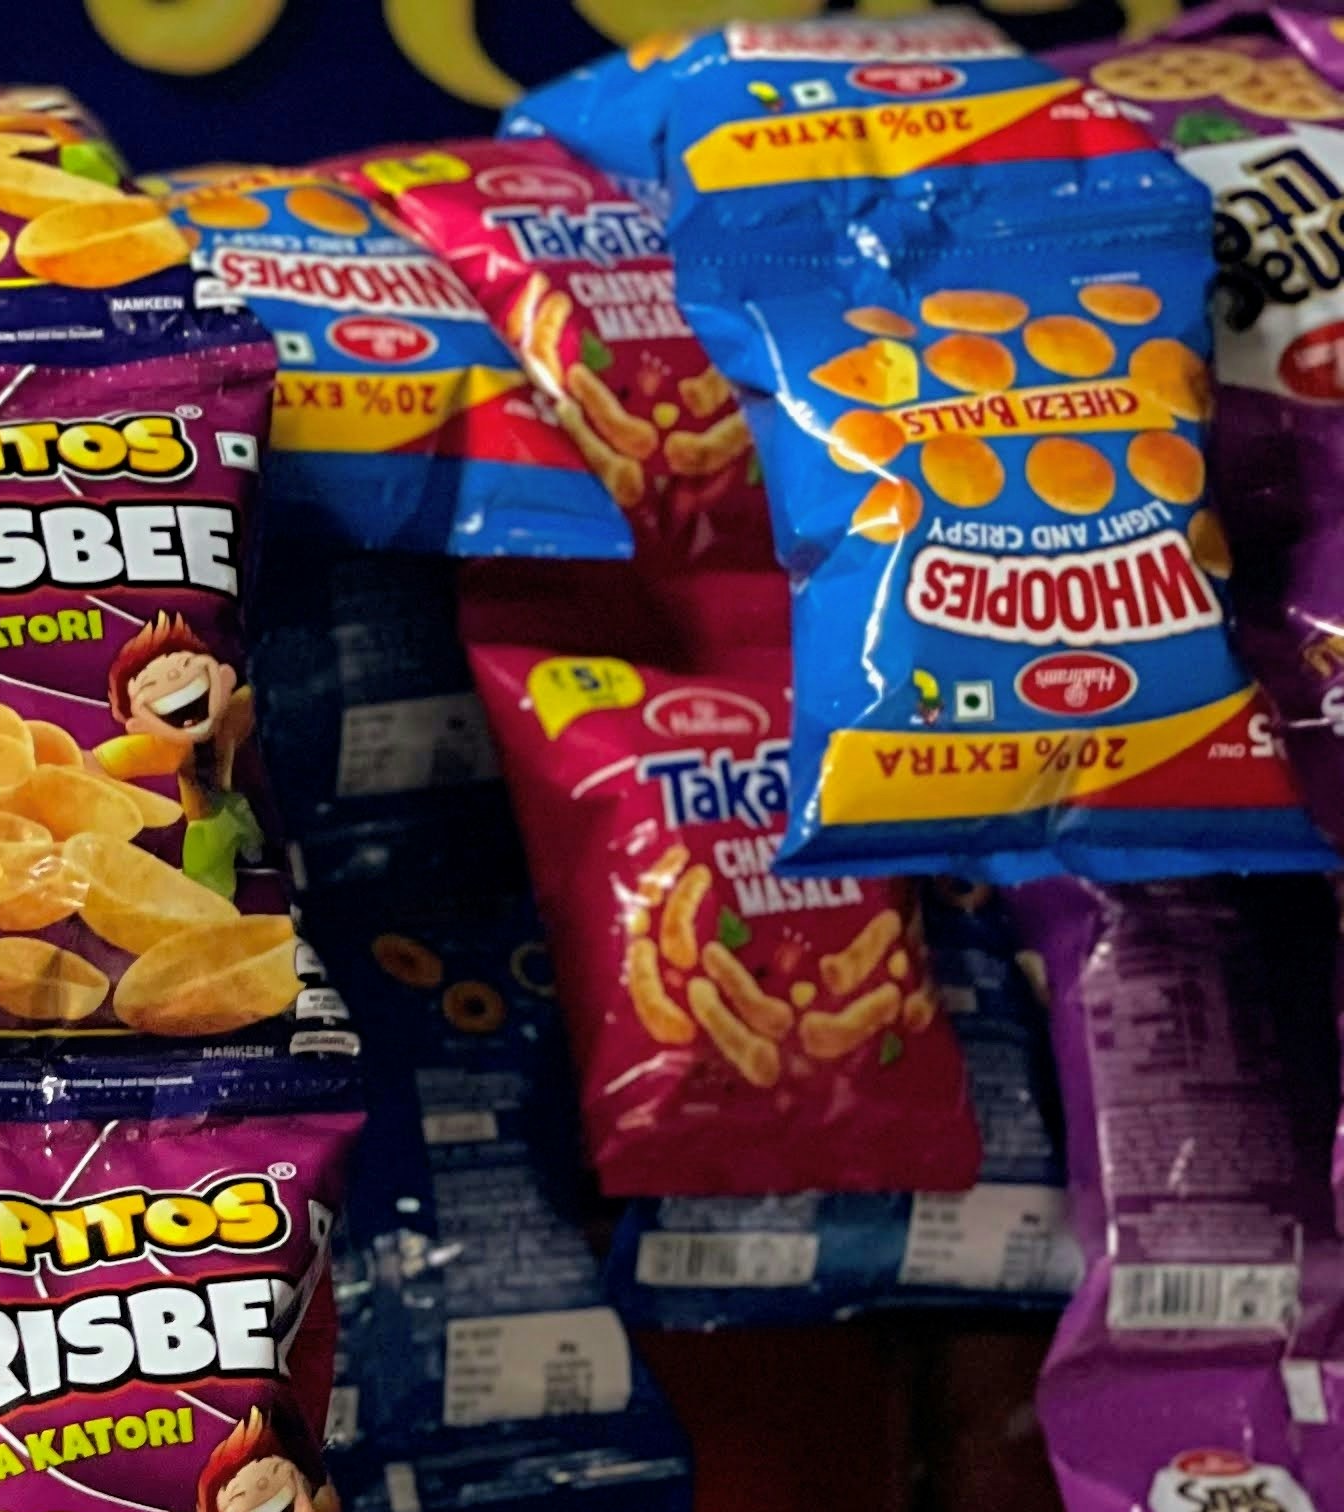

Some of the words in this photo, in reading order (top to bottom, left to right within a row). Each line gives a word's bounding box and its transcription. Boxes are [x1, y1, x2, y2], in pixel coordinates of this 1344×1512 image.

[731, 115, 868, 152] EXTRA
[877, 104, 975, 142] 20%
[111, 296, 184, 312] NAMKEEN
[901, 397, 1019, 436] BALLS
[1026, 387, 1140, 429] CHEEZI
[927, 516, 1022, 552] CRISPY
[1031, 518, 1091, 550] AND
[1100, 499, 1171, 540] LIGHT
[920, 551, 1213, 632] WHOOPIES
[871, 741, 1020, 777] EXTRA
[1034, 734, 1130, 772] 20%
[25, 1406, 195, 1473] KATORI
